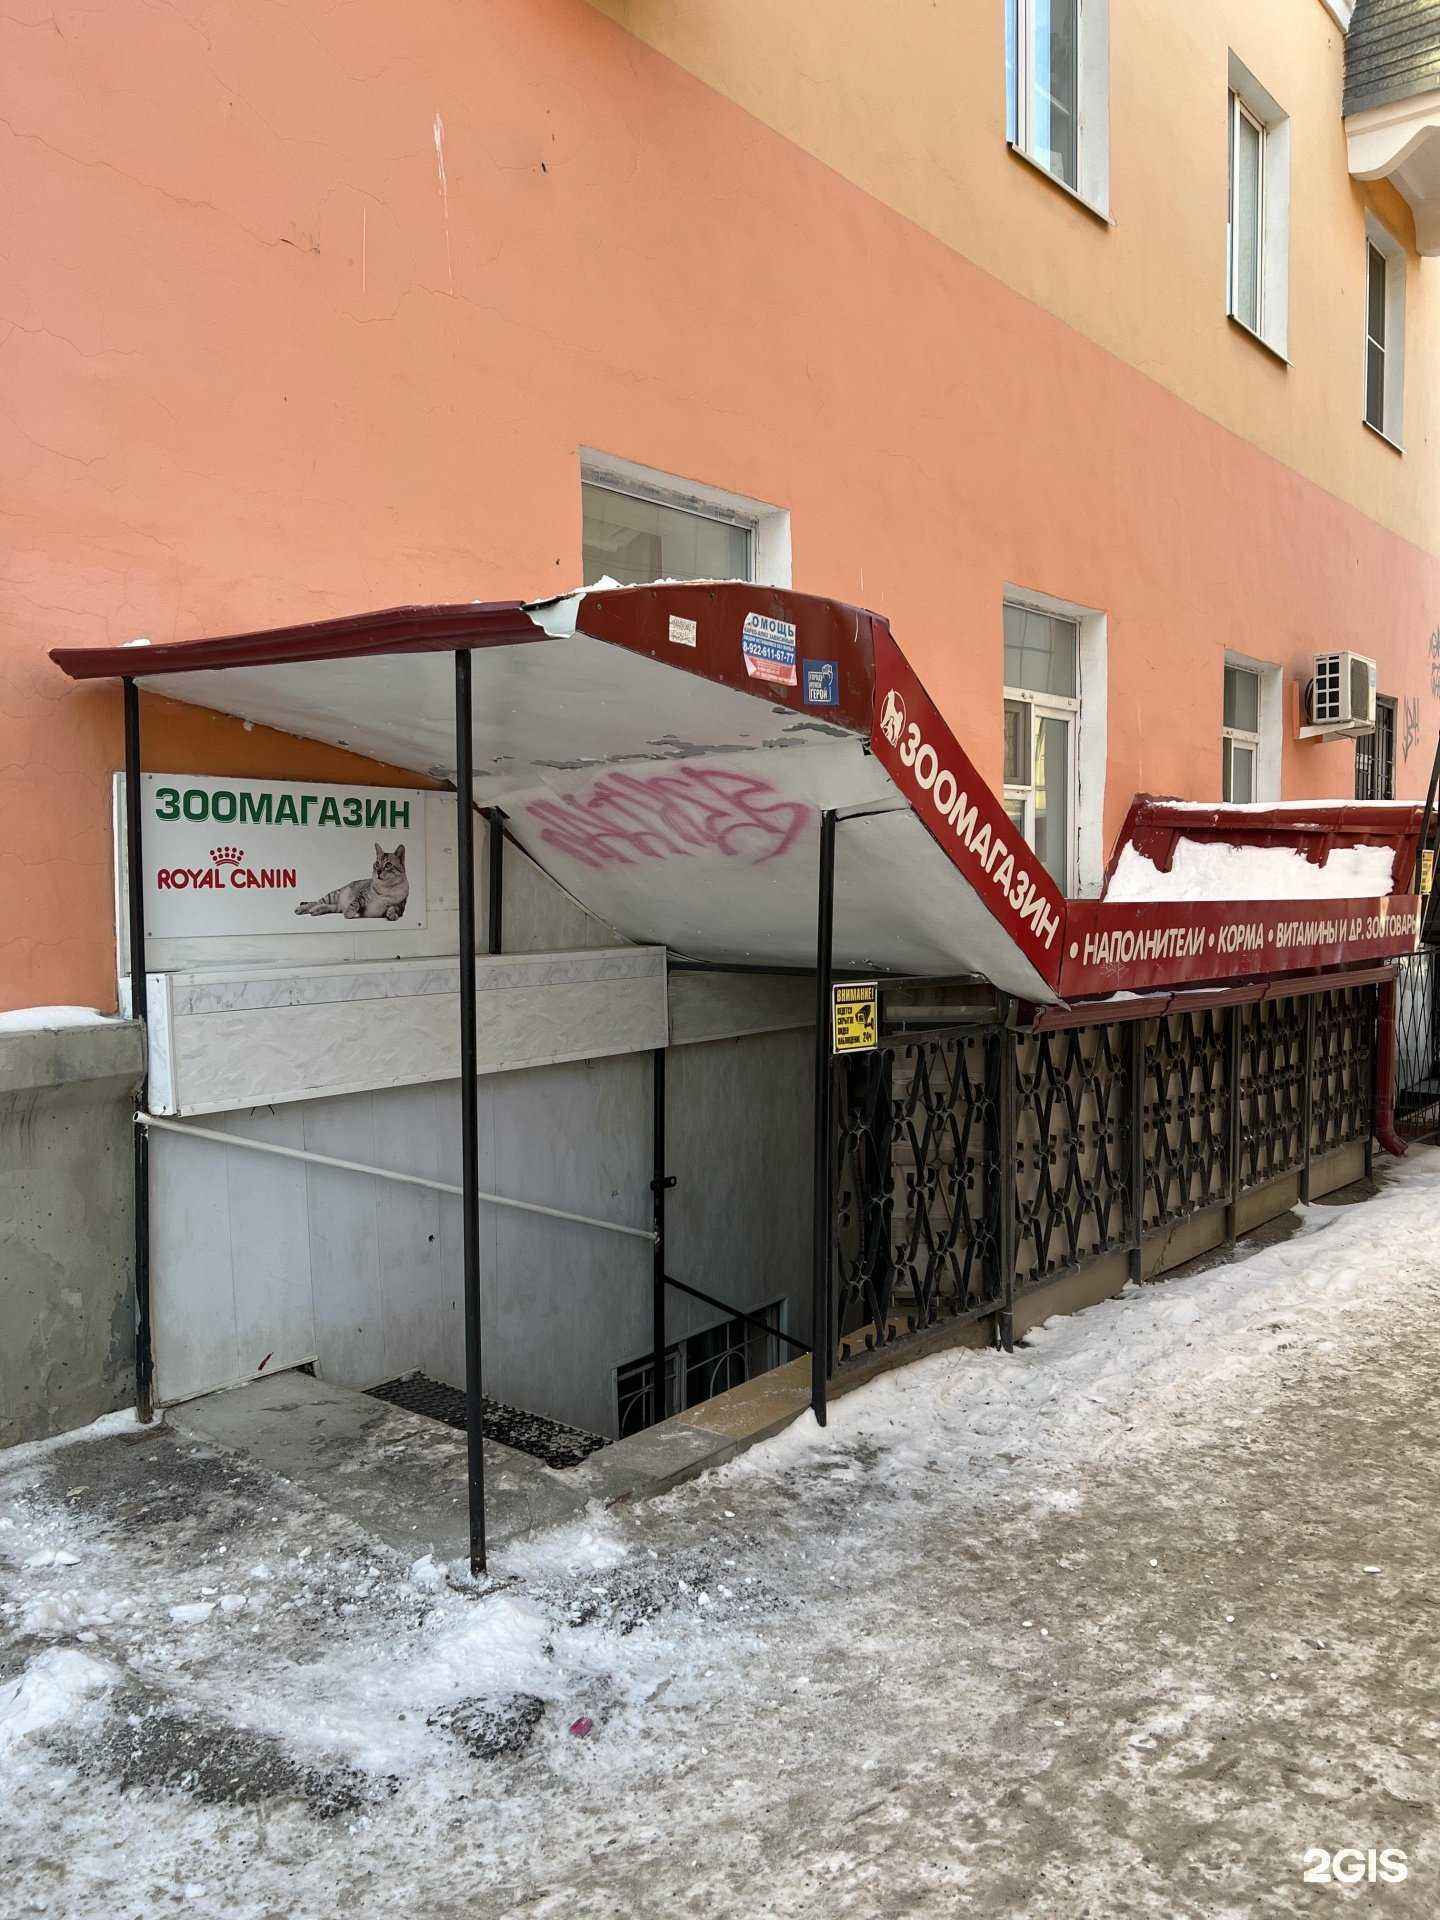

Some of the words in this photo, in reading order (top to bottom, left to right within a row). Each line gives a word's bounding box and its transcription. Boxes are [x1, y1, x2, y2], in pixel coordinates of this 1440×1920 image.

[748, 616, 794, 637] ОМОЩЬ
[155, 787, 411, 829] ЗООМАГАЗИН
[900, 723, 1060, 950] ЗООМАГАЗИН
[157, 868, 226, 890] ROYAL
[230, 868, 297, 889] CANIN
[1083, 926, 1206, 966] НАПОЛНИТЕЛИ
[1217, 922, 1264, 954] КОРМА
[1276, 920, 1338, 948] ВИТАМИНЫ
[1339, 918, 1348, 943] И
